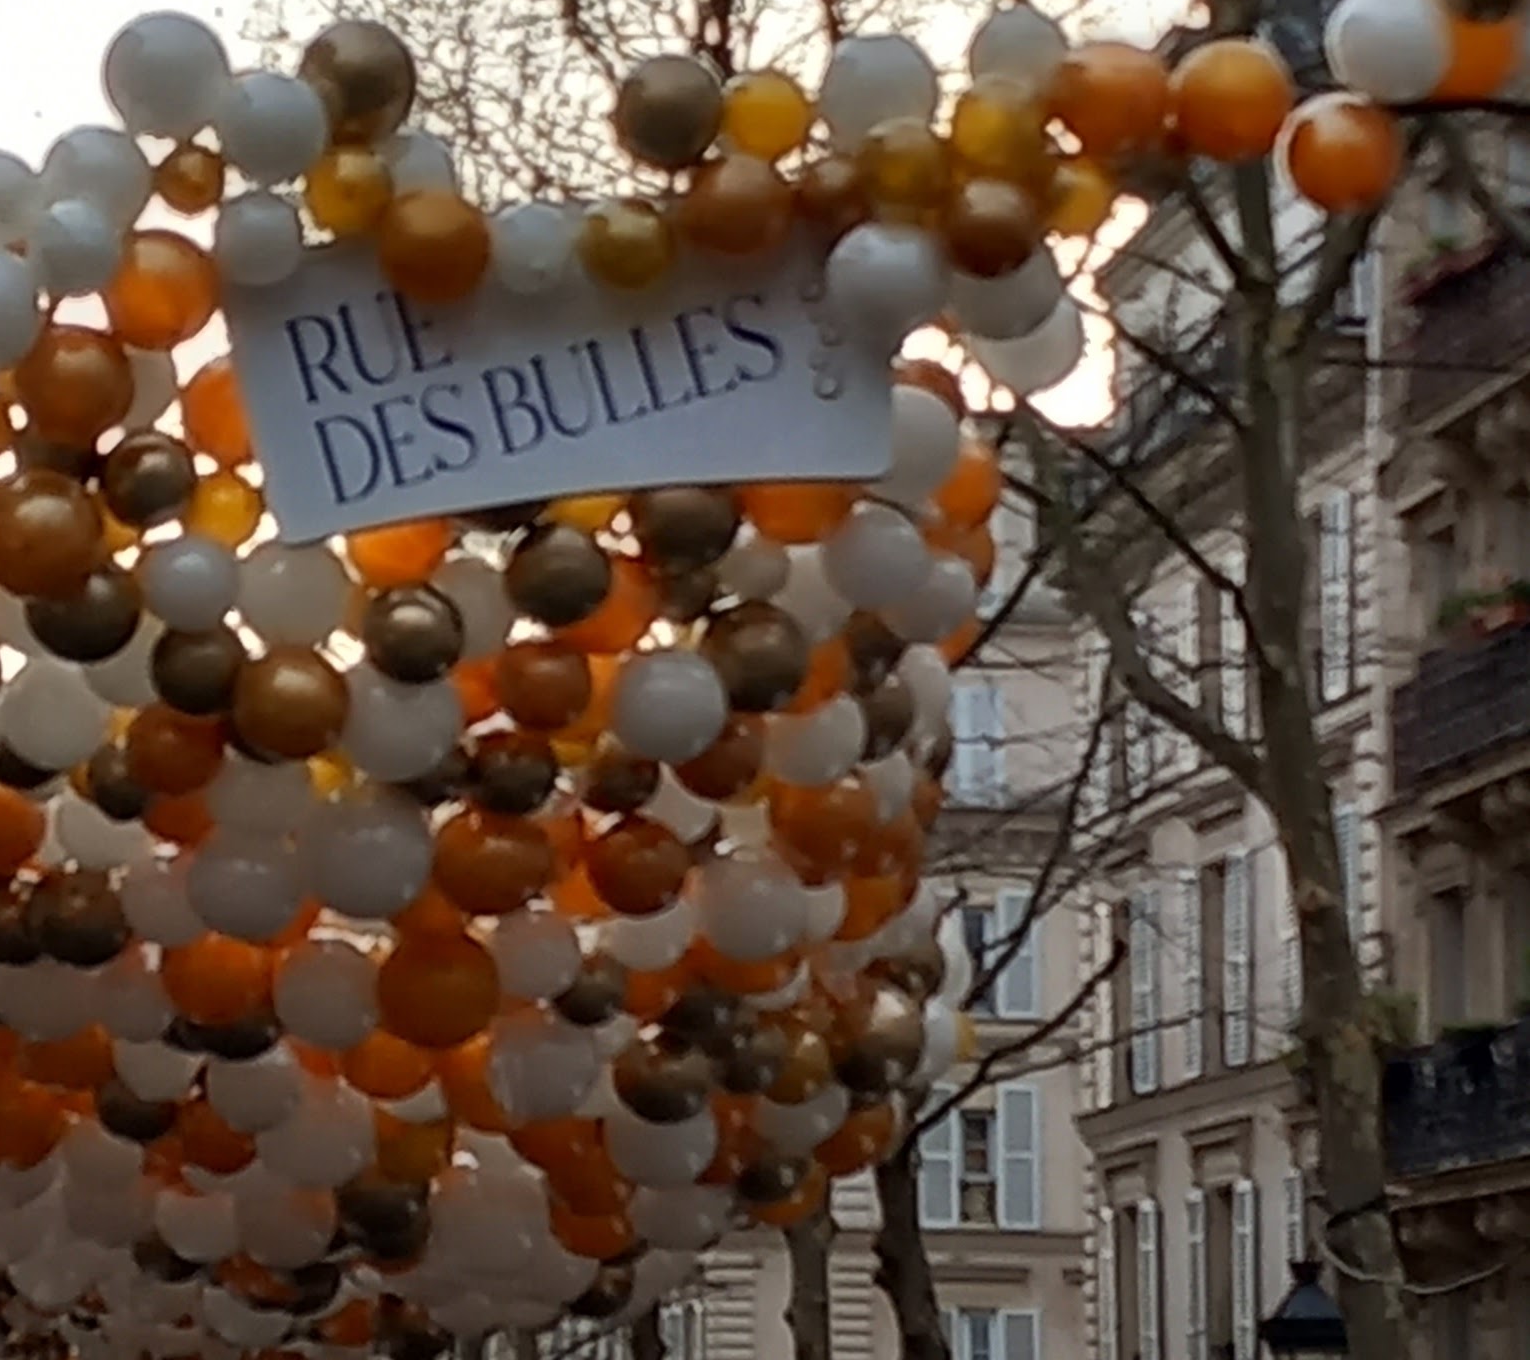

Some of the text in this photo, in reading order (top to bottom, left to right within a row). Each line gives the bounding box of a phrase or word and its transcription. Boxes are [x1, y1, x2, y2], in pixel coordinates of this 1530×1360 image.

[285, 290, 454, 403] RUE
[314, 295, 787, 505] DES BULLES
